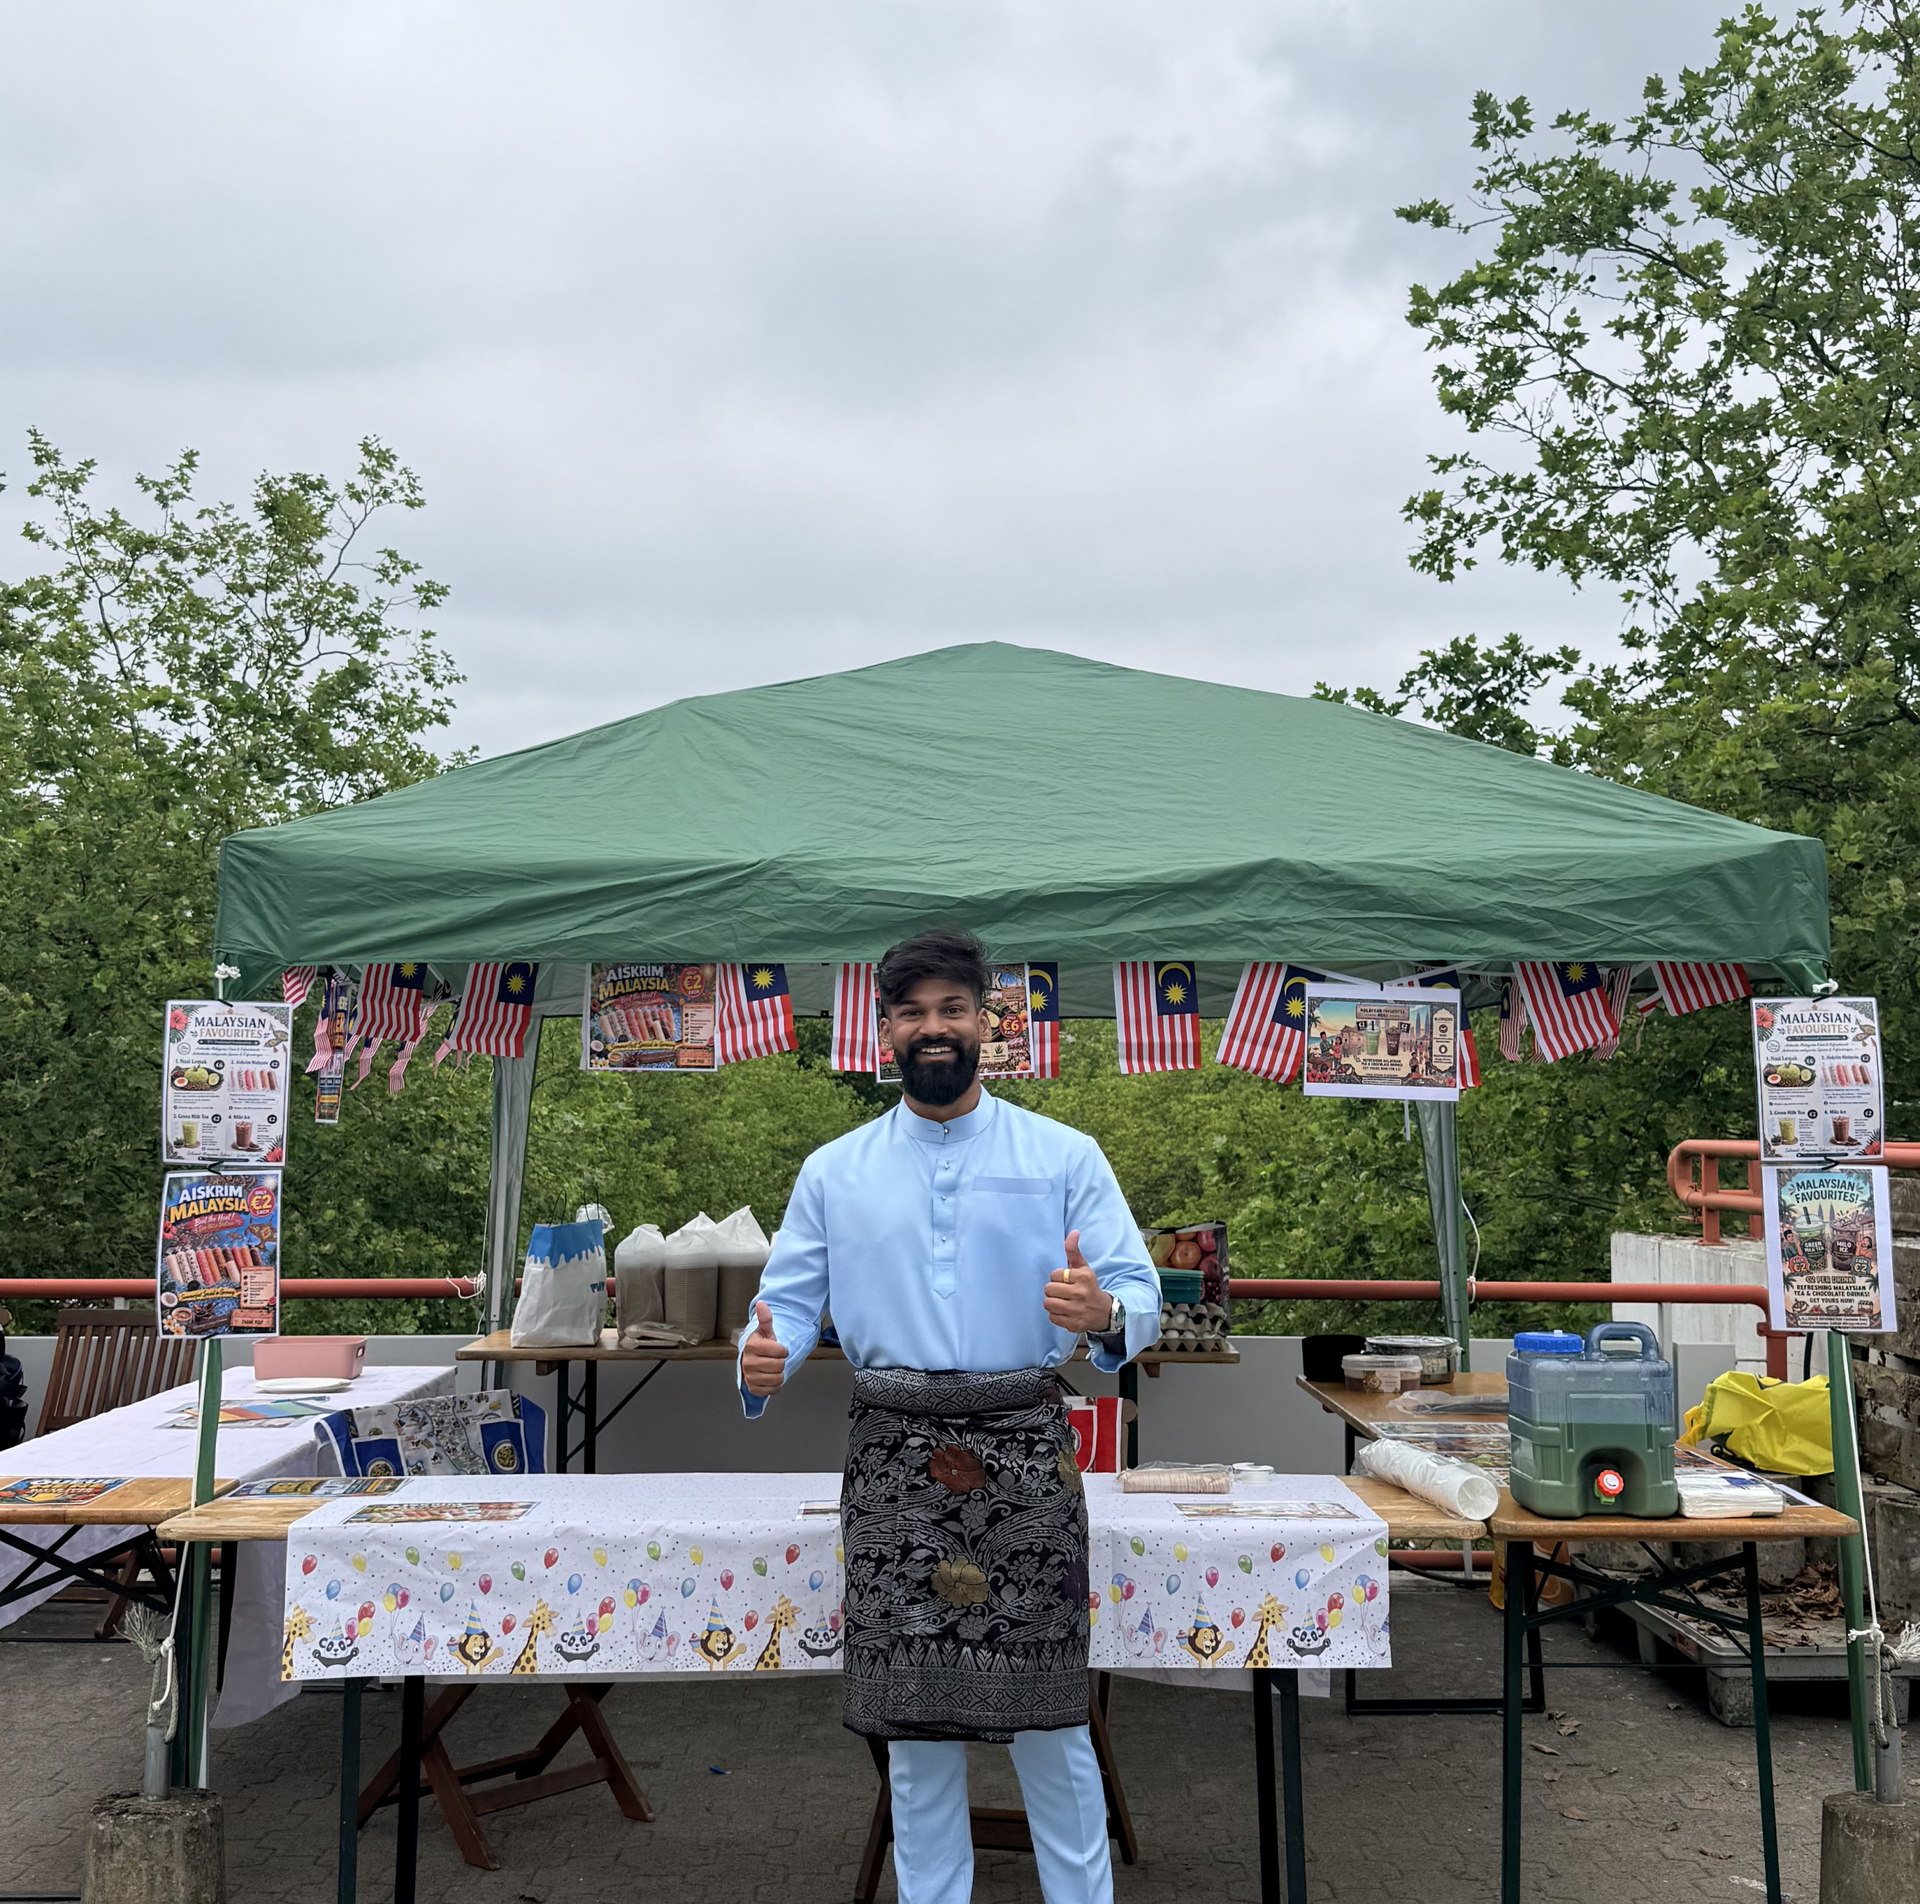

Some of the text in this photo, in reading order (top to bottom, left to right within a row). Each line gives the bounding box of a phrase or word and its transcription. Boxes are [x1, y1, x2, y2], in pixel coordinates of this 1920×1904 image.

[606, 965, 664, 983] AISKRIM
[598, 977, 670, 1001] MALAYSIA
[683, 975, 702, 990] €2
[194, 1016, 266, 1029] MALAYSIAN
[1780, 1013, 1851, 1024] MALAYSIAN
[1002, 1020, 1020, 1031] €6
[1787, 1024, 1850, 1034] FAVOURITES
[199, 1028, 263, 1039] FAVOURITES
[1796, 1178, 1856, 1192] MALAYSIAN
[178, 1185, 243, 1204] AISKRIM
[1795, 1190, 1859, 1204] FAVOURITES!
[251, 1195, 272, 1210] €2
[169, 1197, 250, 1224] MALAYSIA
[194, 1217, 208, 1227] Beat
[207, 1215, 216, 1223] the
[1793, 1264, 1806, 1272] €2
[1854, 1264, 1867, 1272] €2
[1817, 1276, 1831, 1284] PER
